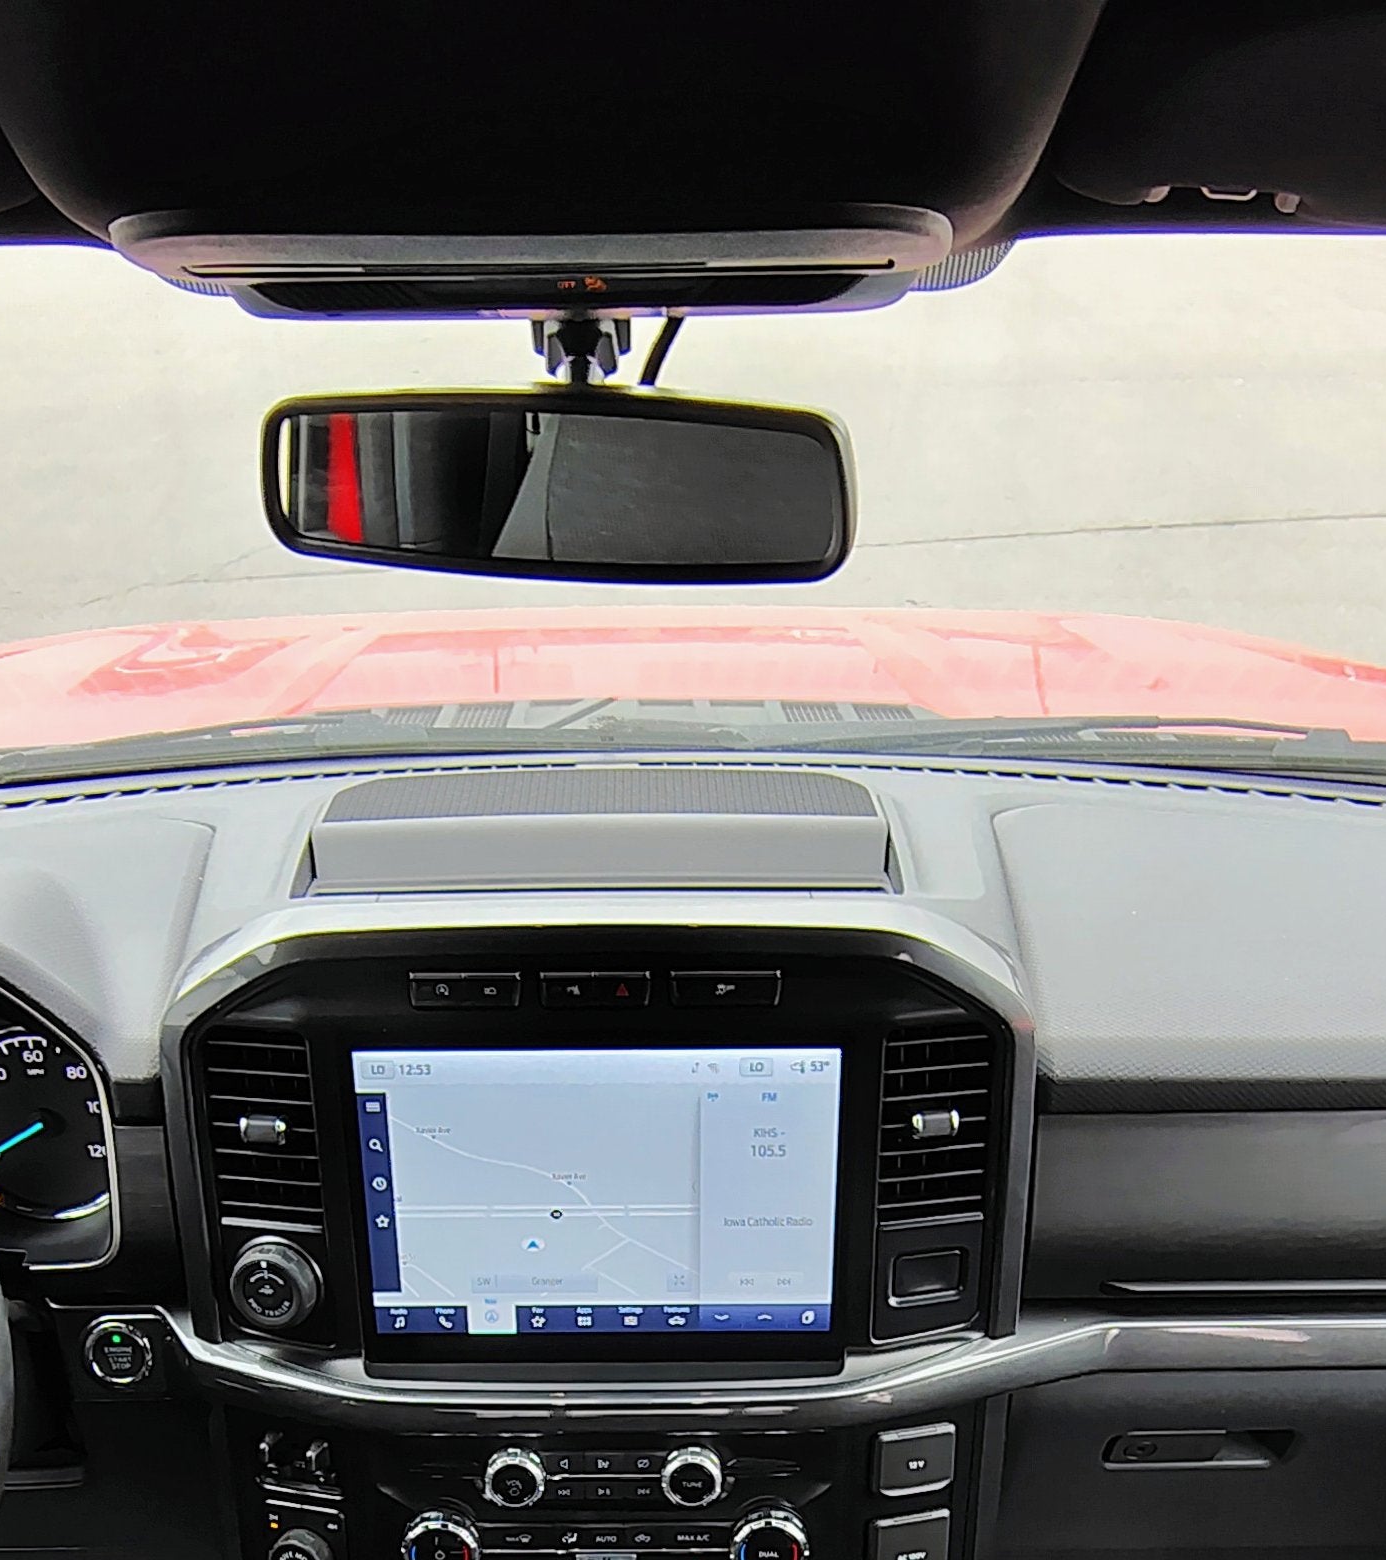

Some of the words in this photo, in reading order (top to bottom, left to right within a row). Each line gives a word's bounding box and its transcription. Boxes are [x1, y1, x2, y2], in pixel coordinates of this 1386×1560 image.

[22, 1050, 43, 1063] 60
[371, 1065, 385, 1075] LO
[399, 1064, 431, 1075] 12:53
[749, 1062, 764, 1072] LO
[810, 1061, 830, 1072] 53°
[66, 1066, 87, 1079] 80
[762, 1093, 777, 1101] FM
[86, 1101, 100, 1113] 10
[754, 1128, 778, 1138] KIHS
[87, 1144, 106, 1158] 12
[751, 1145, 786, 1157] 105.5
[724, 1218, 745, 1227] Iowa
[747, 1217, 784, 1227] Catholic
[786, 1218, 813, 1227] Radio
[477, 1278, 491, 1286] SW
[532, 1277, 563, 1287] Granger
[248, 1298, 262, 1313] PRO
[265, 1301, 291, 1316] TRAILER
